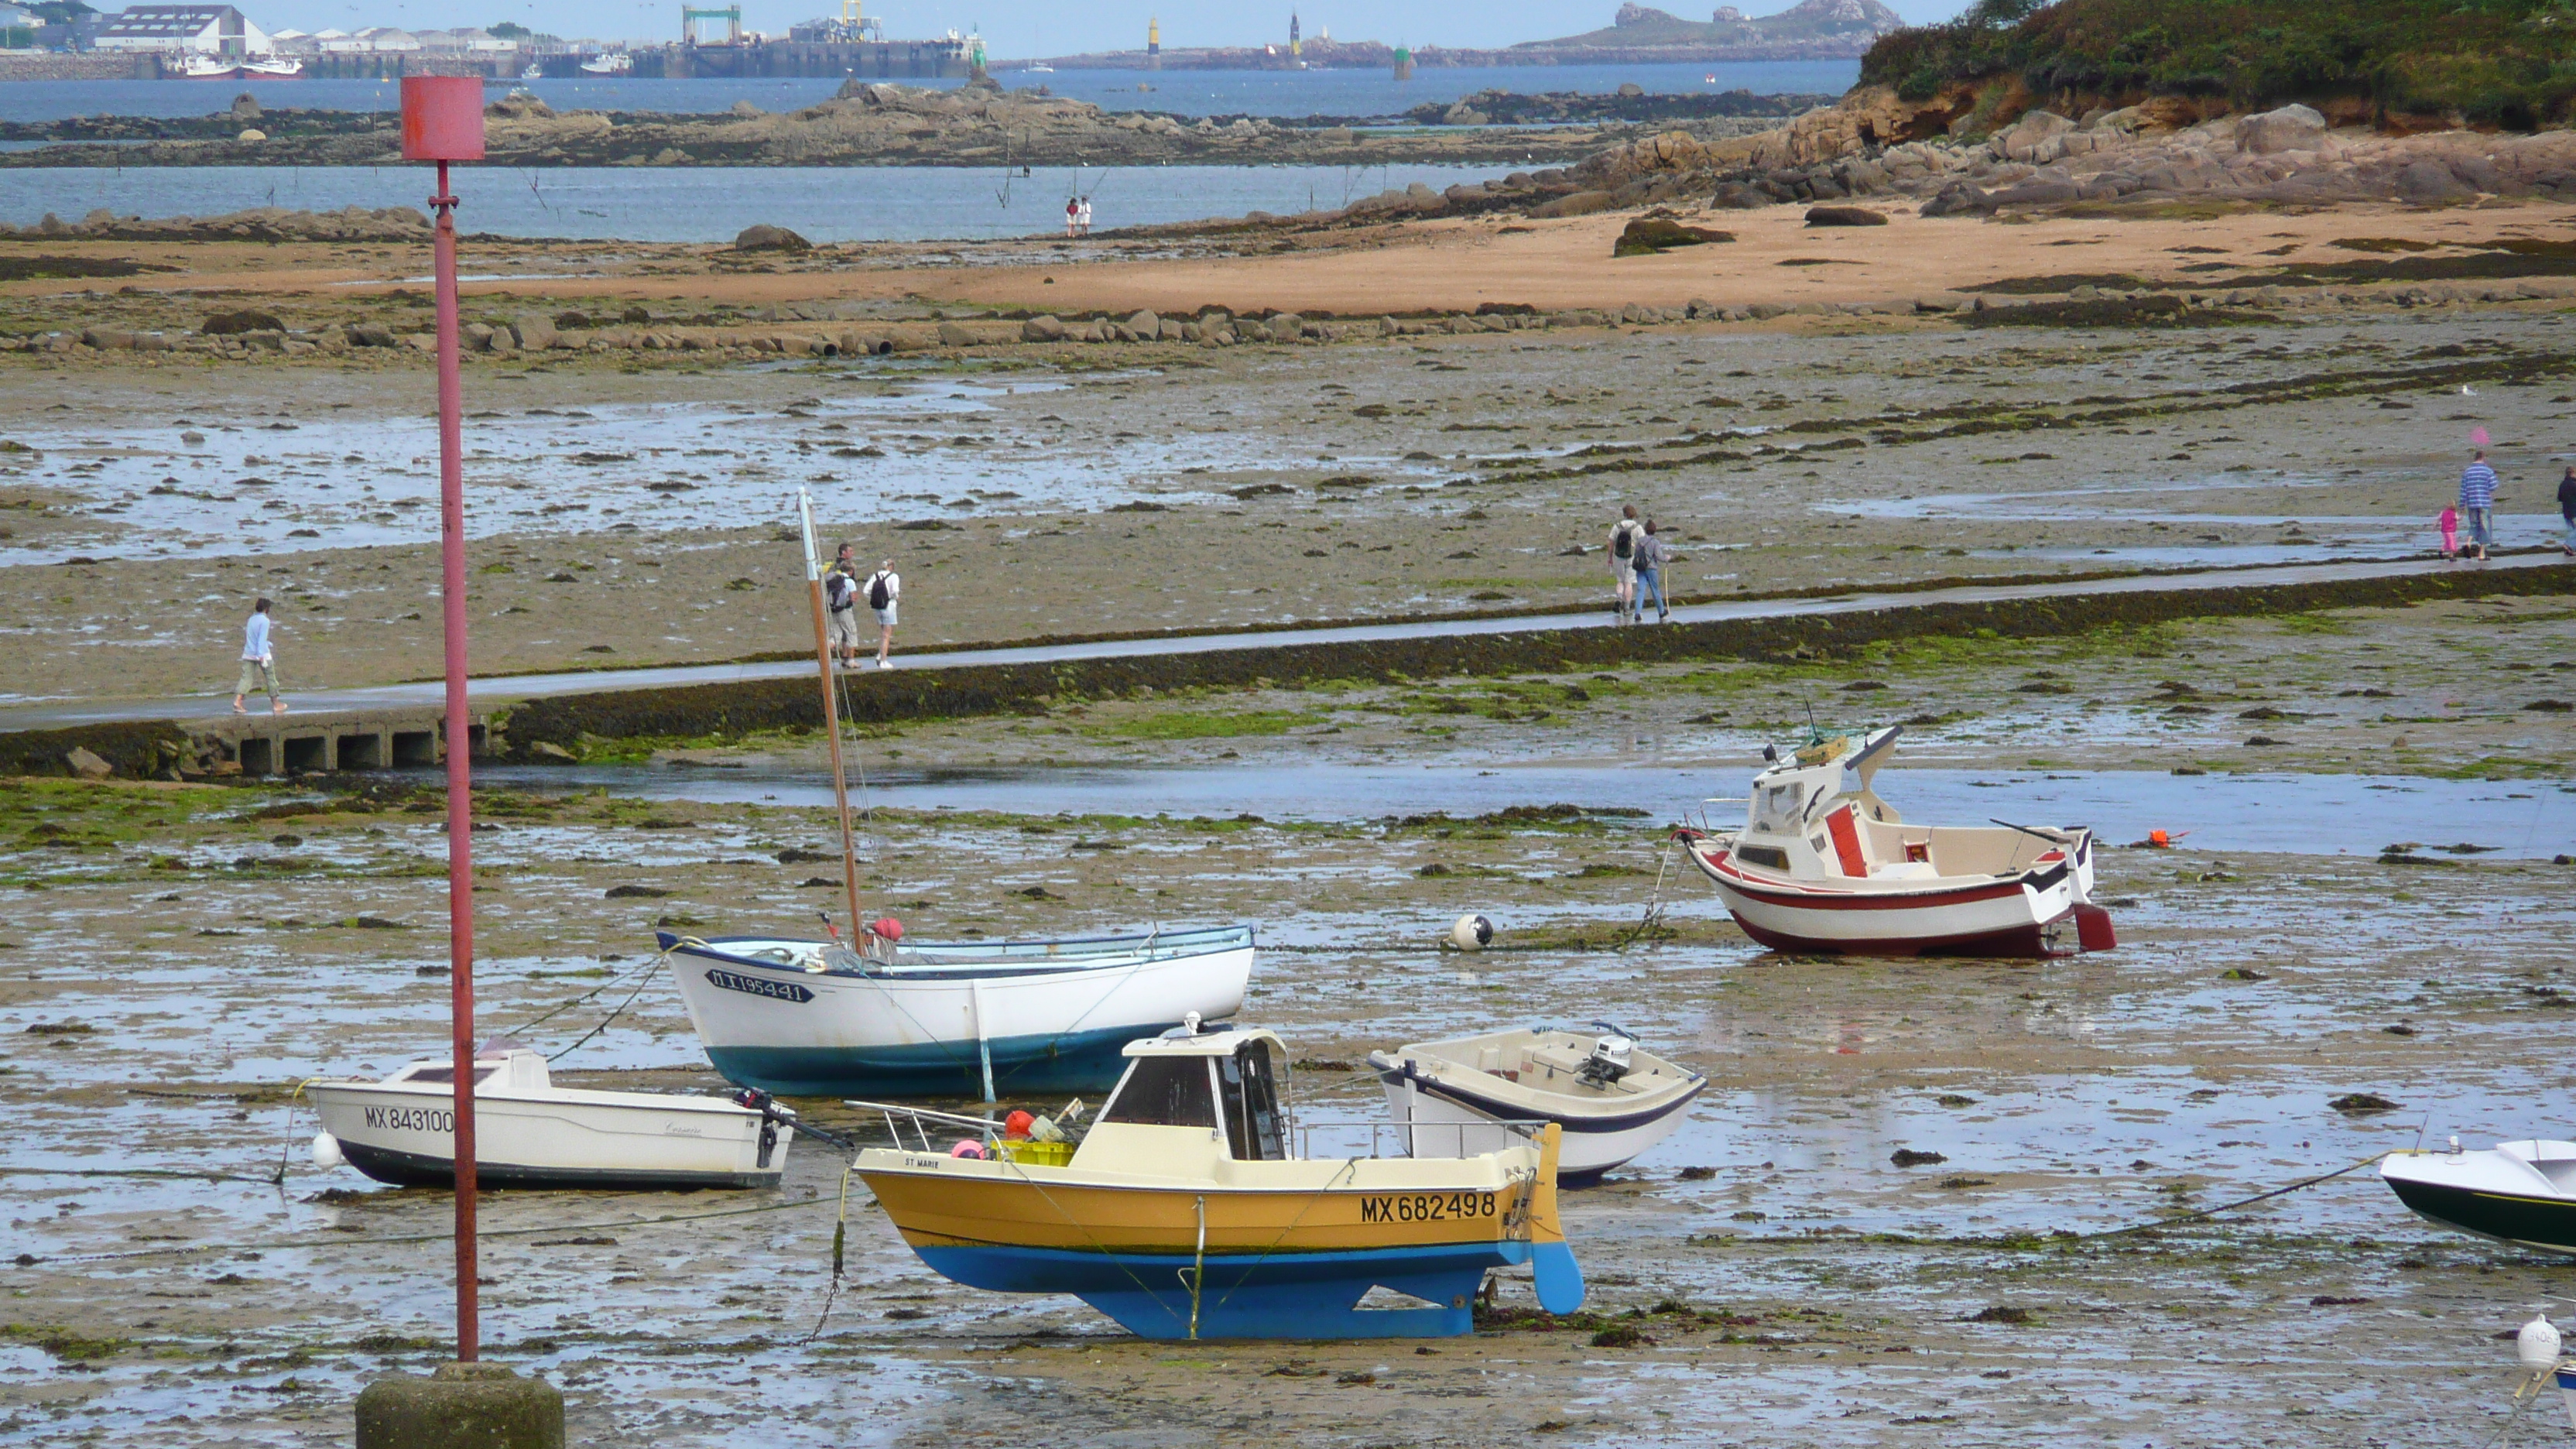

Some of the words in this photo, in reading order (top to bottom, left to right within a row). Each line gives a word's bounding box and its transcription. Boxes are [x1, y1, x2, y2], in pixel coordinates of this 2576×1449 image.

[365, 1107, 388, 1129] MX
[389, 1108, 454, 1132] 843100
[917, 1160, 939, 1169] MARIE
[1362, 1197, 1394, 1222] MX
[1398, 1192, 1495, 1221] 682498
